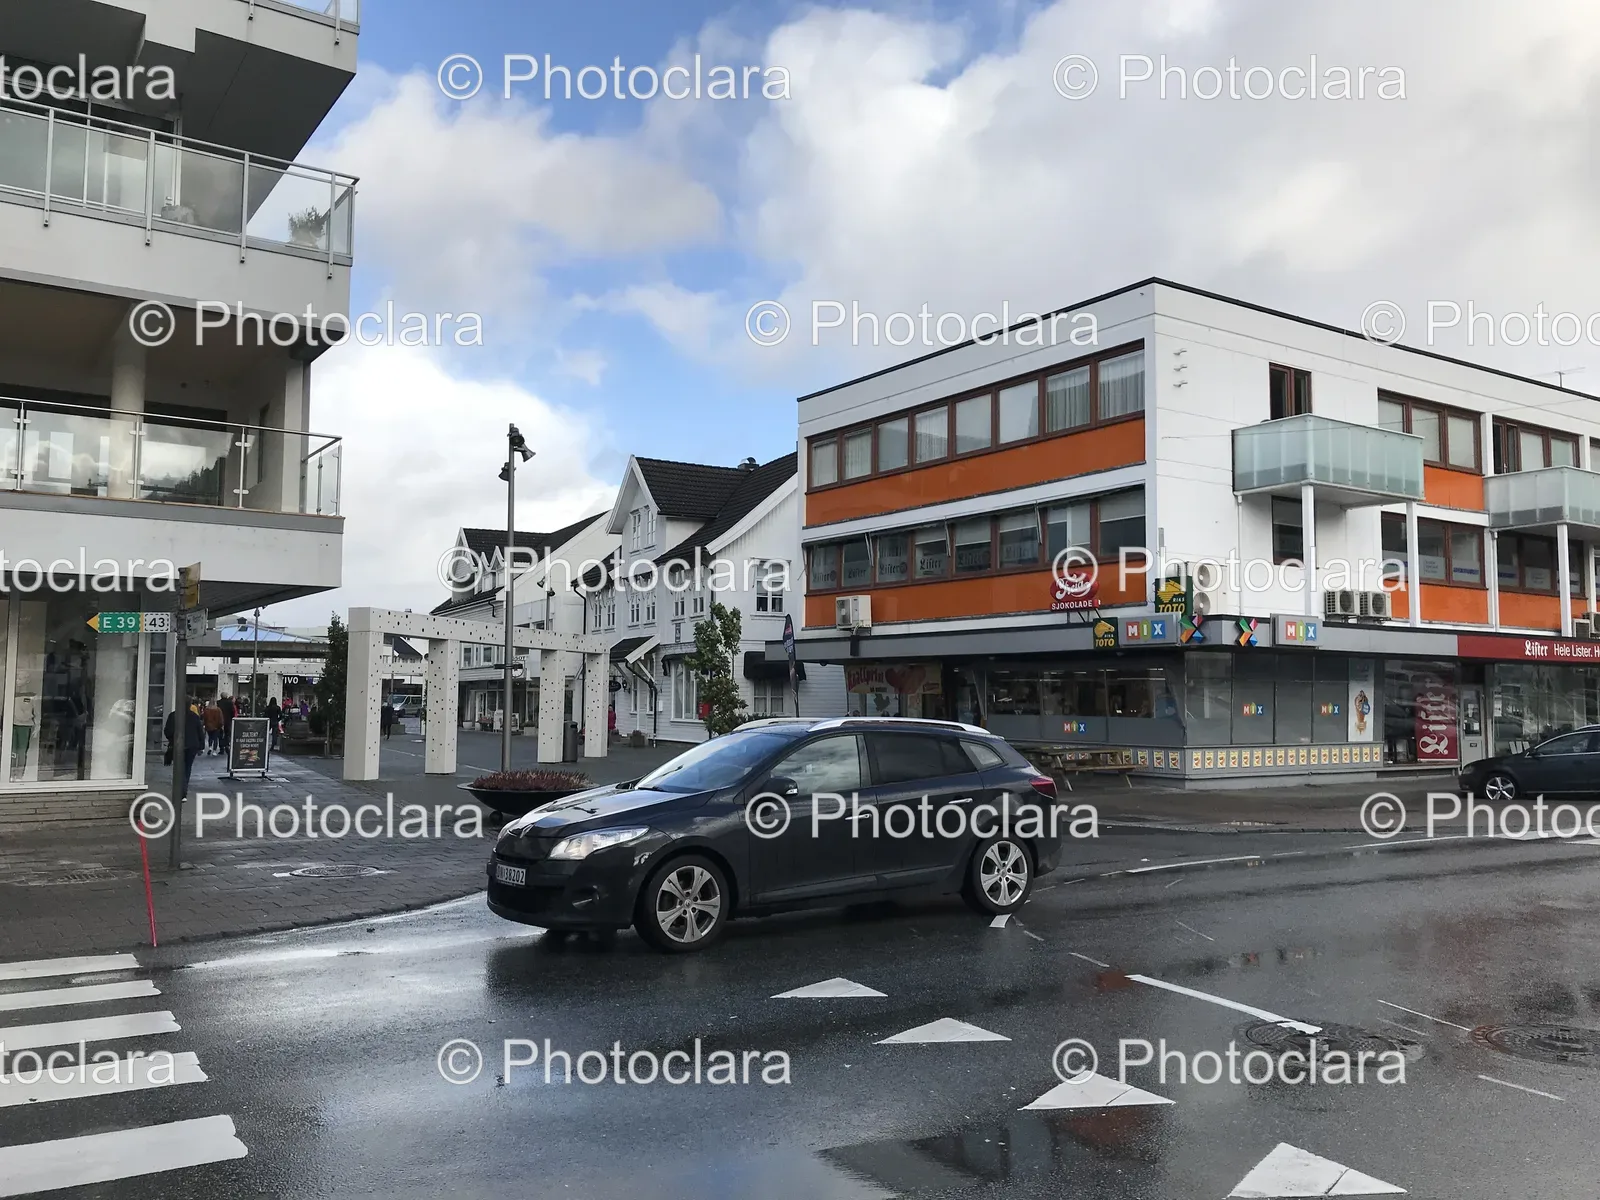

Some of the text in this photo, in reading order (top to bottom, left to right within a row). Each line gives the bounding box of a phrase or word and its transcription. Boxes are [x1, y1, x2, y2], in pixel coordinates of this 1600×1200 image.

[1051, 599, 1093, 611] SJOKOLADE
[1158, 603, 1185, 614] TOTO
[103, 617, 136, 629] E 39
[149, 617, 165, 628] 43
[1127, 622, 1163, 638] MIX
[1286, 623, 1316, 639] MIX
[1095, 638, 1115, 647] TOTO
[1525, 640, 1549, 658] Lister
[1554, 643, 1571, 656] Hele
[1572, 644, 1593, 657] Lister.
[283, 676, 299, 684] IVO
[1243, 704, 1263, 714] MIX
[1321, 704, 1340, 714] MIX
[1064, 722, 1085, 732] MIX
